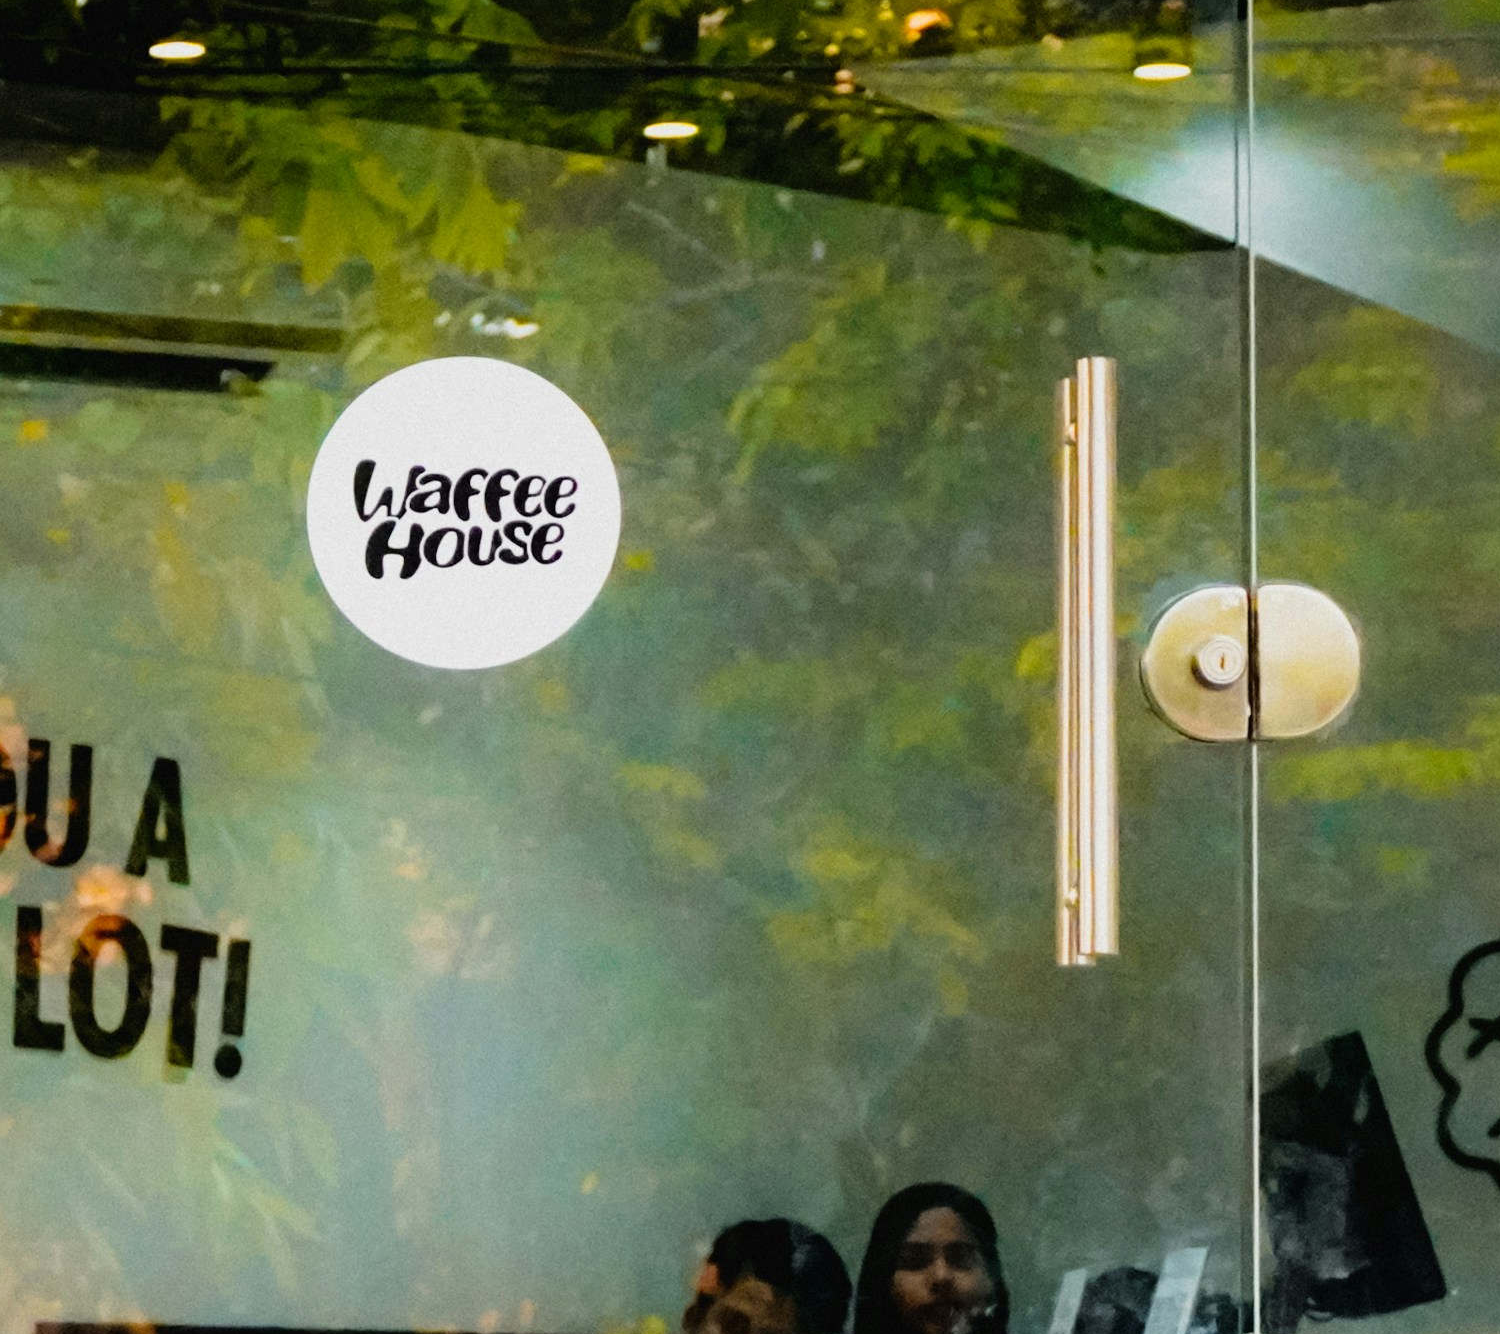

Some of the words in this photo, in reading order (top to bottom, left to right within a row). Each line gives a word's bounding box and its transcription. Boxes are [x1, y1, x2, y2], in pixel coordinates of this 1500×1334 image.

[353, 459, 578, 522] Waffee
[125, 757, 192, 886] A
[12, 904, 252, 1079] LOT!
